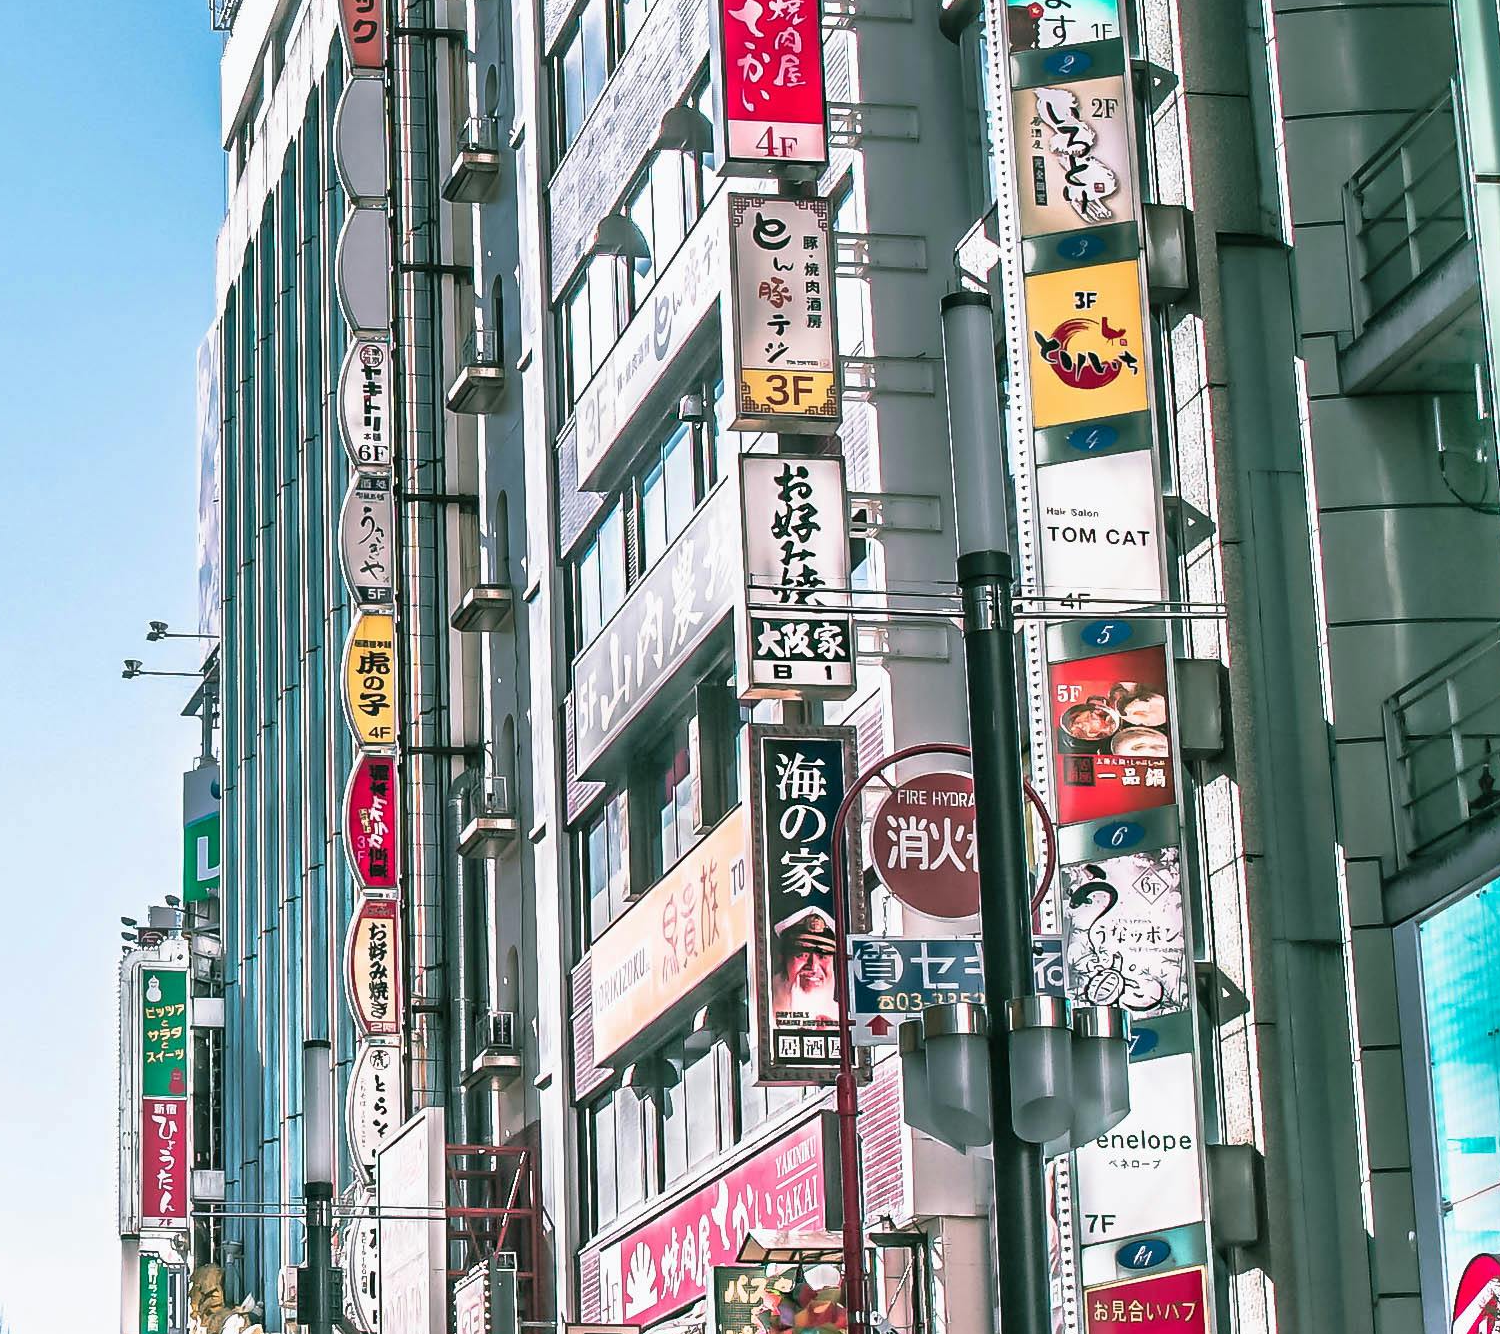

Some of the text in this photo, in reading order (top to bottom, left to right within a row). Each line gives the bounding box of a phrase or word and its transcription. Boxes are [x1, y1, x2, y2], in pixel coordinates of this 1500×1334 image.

[1091, 22, 1114, 38] 1F
[1091, 98, 1119, 119] 2F
[755, 125, 798, 159] 4F
[803, 235, 823, 329] 豚・焼肉酒房
[1074, 291, 1098, 310] 3F
[765, 374, 814, 406] 3F
[358, 444, 389, 462] 6F
[358, 506, 385, 580] うさぎや
[1047, 527, 1151, 547] TOM CAT
[367, 588, 386, 600] 5F
[757, 621, 846, 660] 大阪家
[355, 650, 391, 717] 虎の子
[1057, 684, 1083, 703] 5F
[368, 726, 392, 739] 4F
[897, 789, 976, 807] FIRE HYDRA
[775, 752, 830, 898] 海の家
[886, 813, 980, 878] 消火
[367, 922, 389, 1020] お好み焼き
[145, 1003, 185, 1019] ピッツア
[147, 1026, 183, 1043] サラダ
[146, 1048, 185, 1063] スイーツ
[153, 1103, 178, 1115] 新宿
[151, 1114, 178, 1214] ひょうたん
[774, 1136, 818, 1180] YAKINIKU
[775, 1173, 819, 1227] SAKAI
[1084, 1214, 1117, 1234] 7F
